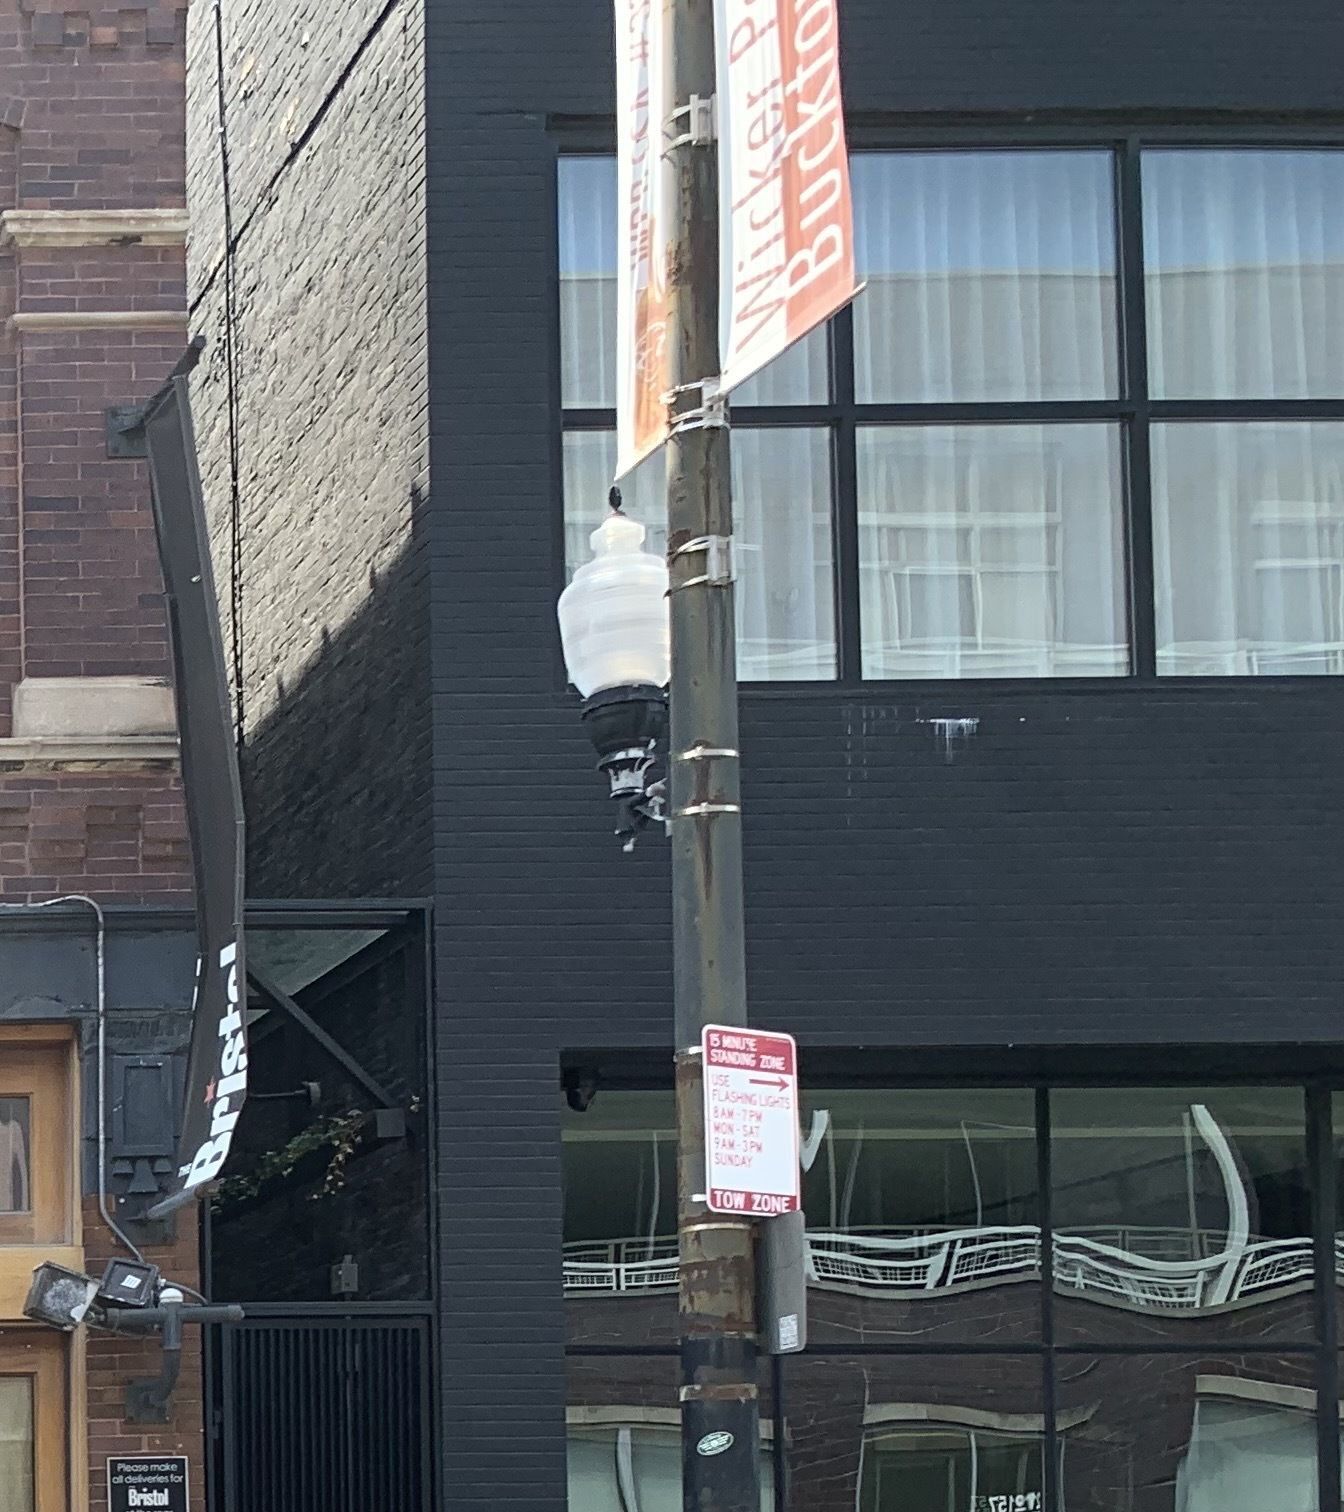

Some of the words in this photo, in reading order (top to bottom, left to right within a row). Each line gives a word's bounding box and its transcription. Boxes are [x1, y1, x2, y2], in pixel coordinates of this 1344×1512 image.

[783, 0, 846, 303] Buckto
[732, 76, 786, 354] Wicker
[722, 1035, 757, 1051] MINUTE
[711, 1049, 756, 1067] STANDING
[760, 1055, 785, 1070] ZONE
[712, 1074, 730, 1087] USE
[712, 1089, 757, 1106] FLASHING
[760, 1094, 790, 1109] LIGHTS
[714, 1152, 752, 1167] SUNDAY
[714, 1191, 745, 1208] TOW
[752, 1194, 790, 1212] ZONE
[117, 1463, 149, 1472] Please
[150, 1463, 177, 1471] make
[112, 1475, 123, 1483] all
[125, 1474, 169, 1483] deliveries
[170, 1474, 183, 1482] for
[128, 1487, 169, 1506] Bristol
